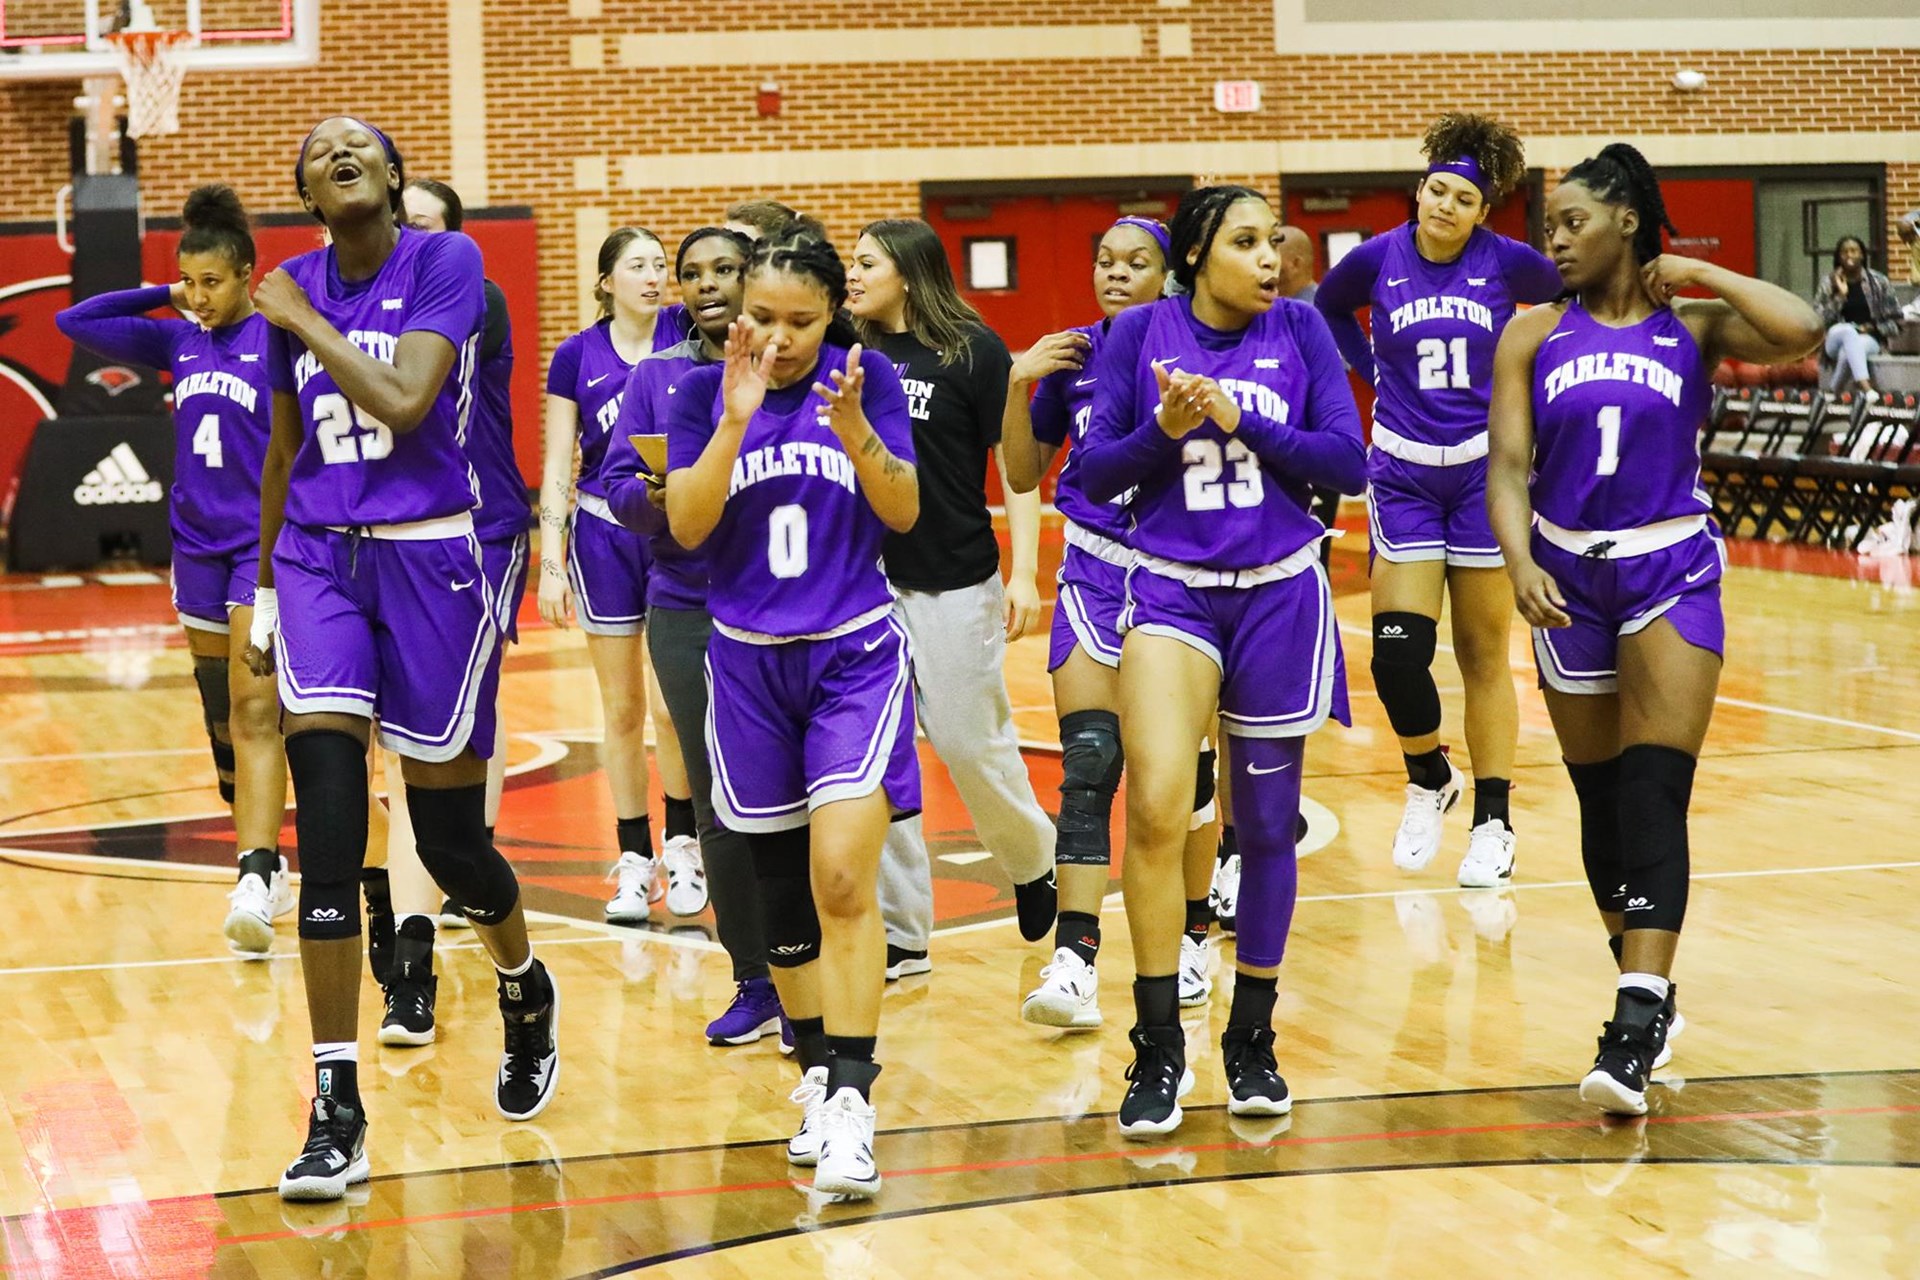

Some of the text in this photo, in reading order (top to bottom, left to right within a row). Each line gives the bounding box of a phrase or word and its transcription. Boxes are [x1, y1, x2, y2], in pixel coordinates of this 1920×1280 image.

[1390, 296, 1493, 334] TARLETON
[899, 379, 935, 399] ON
[1416, 337, 1471, 390] 21
[1545, 352, 1683, 408] TARLETON
[176, 371, 257, 414] TARLETON
[193, 414, 223, 467] 4
[1596, 405, 1621, 475] 1
[73, 481, 163, 505] adidas
[726, 442, 855, 501] ARLETON
[1182, 437, 1265, 511] 23
[768, 504, 808, 579] 0
